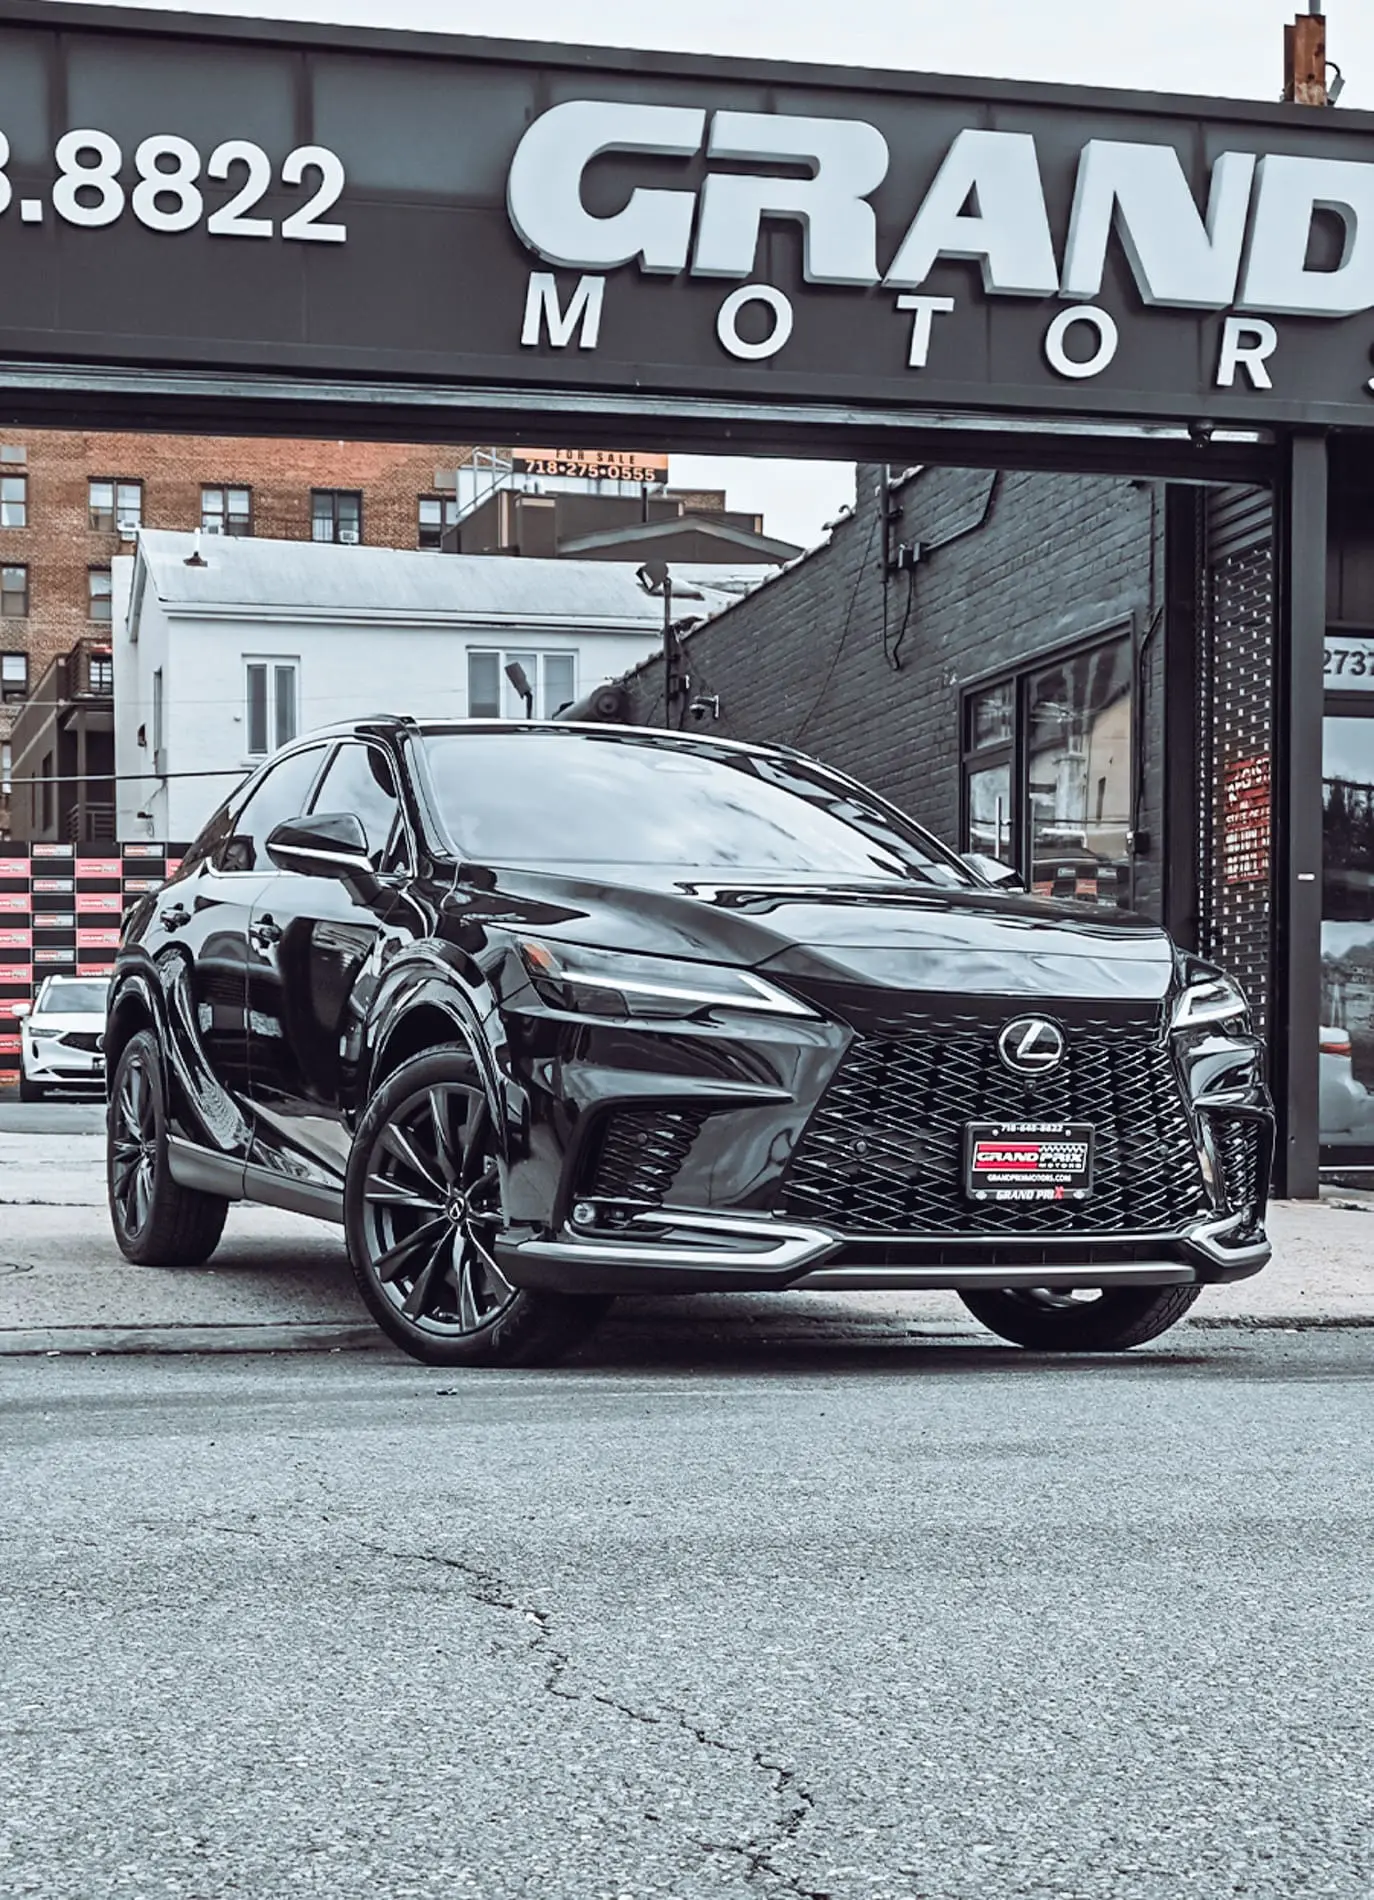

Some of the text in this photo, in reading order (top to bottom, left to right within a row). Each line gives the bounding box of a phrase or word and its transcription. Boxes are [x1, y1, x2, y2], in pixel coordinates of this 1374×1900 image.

[507, 99, 1374, 317] GRAND
[521, 271, 1374, 389] MOTOR
[556, 449, 636, 465] FOR SALE
[976, 1152, 1083, 1162] GRAND PRIX
[995, 1185, 1065, 1200] GRAND PRIX
